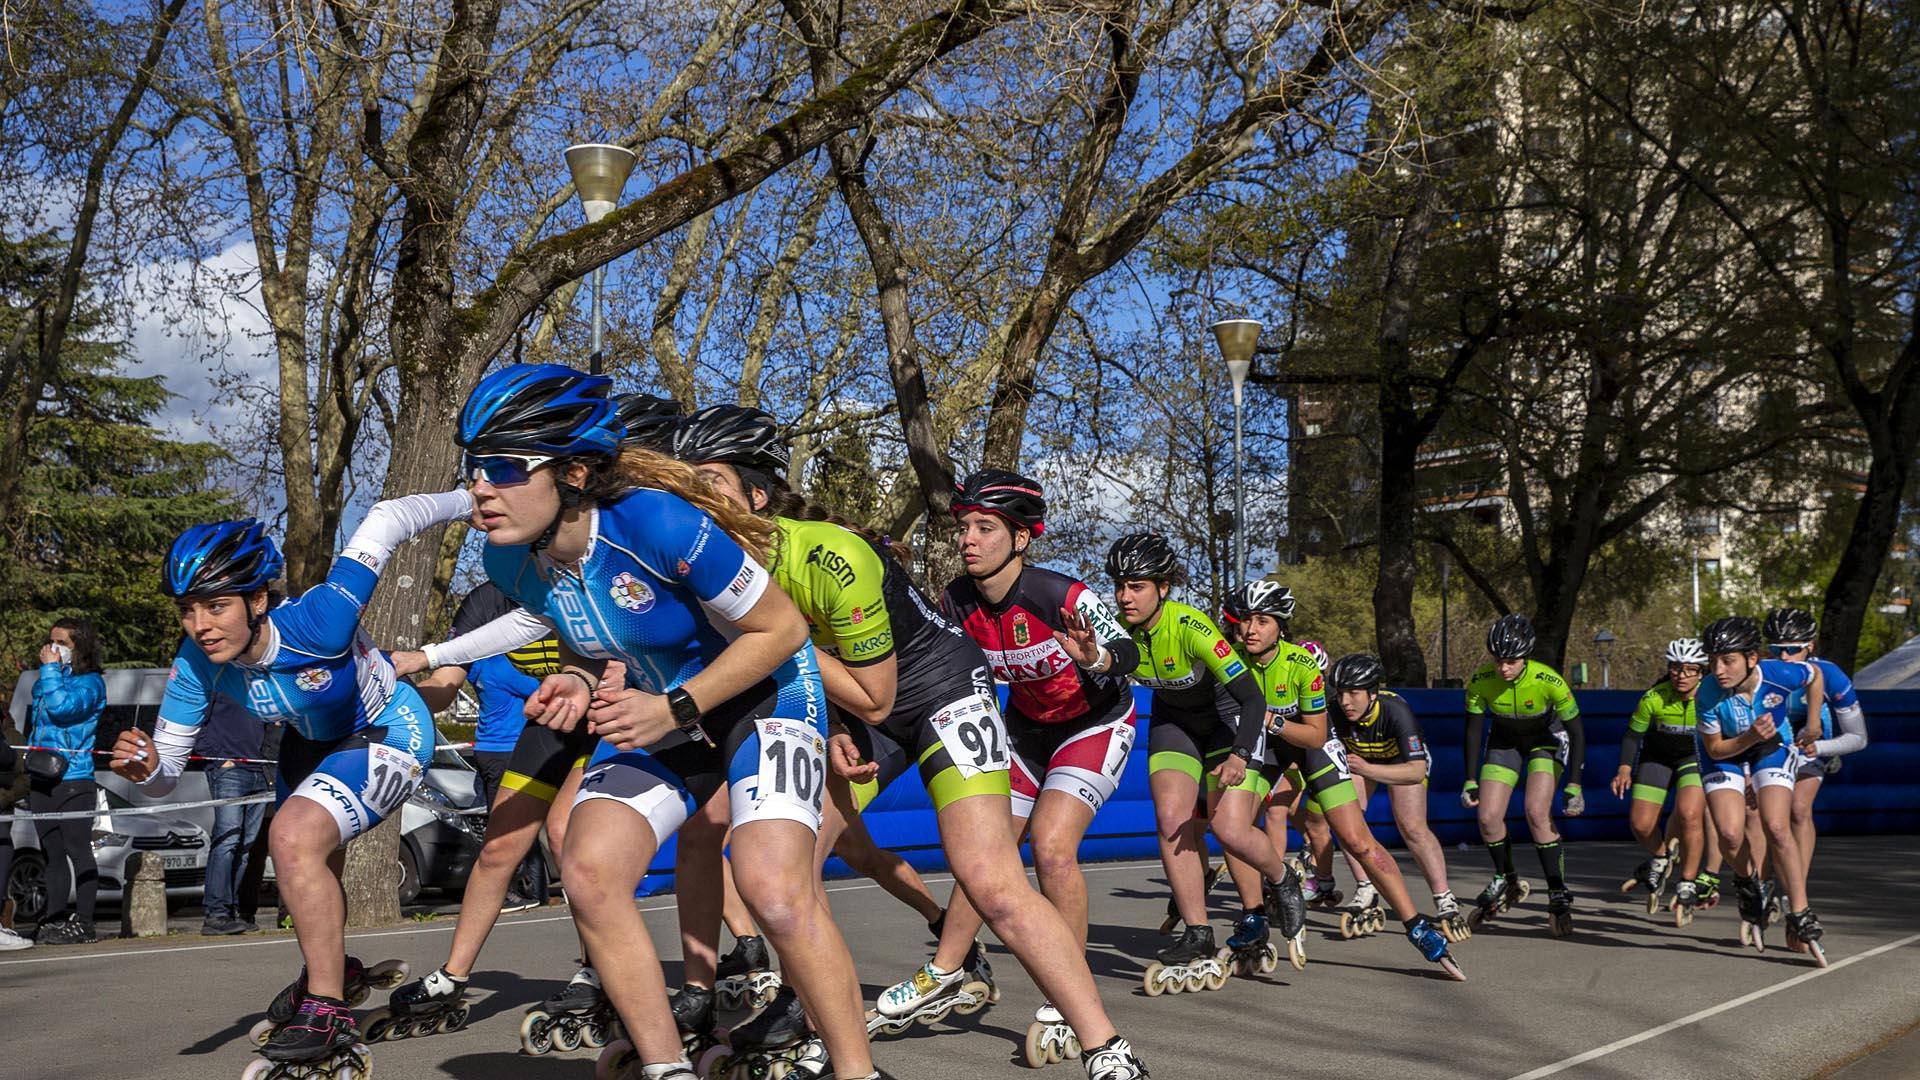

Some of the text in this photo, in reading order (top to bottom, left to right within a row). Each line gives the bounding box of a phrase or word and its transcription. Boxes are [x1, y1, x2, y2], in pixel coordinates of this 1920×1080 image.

[822, 550, 857, 590] nsm
[1189, 618, 1213, 636] nsm
[997, 642, 1052, 662] DEPORTIVA
[1295, 654, 1317, 671] nsm
[957, 715, 1005, 767] 92
[764, 739, 824, 814] 102
